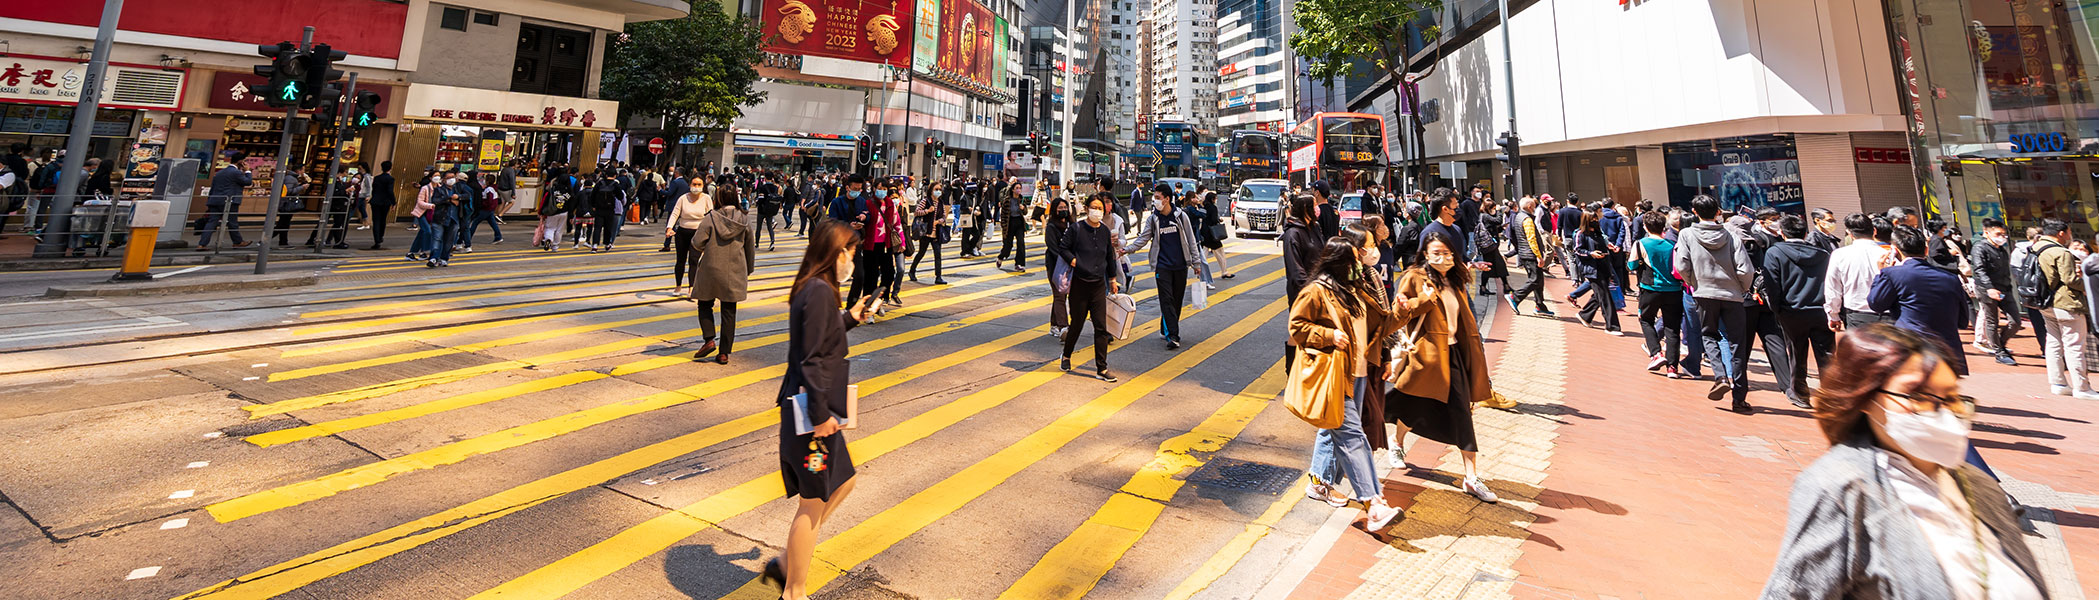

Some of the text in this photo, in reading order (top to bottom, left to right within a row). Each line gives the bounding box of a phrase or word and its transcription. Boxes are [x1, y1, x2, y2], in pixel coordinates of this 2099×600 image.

[827, 13, 858, 23] HAPPY
[827, 21, 857, 30] CHINESE
[826, 33, 856, 48] 2023
[431, 109, 535, 124] BEE CHENG HIANG
[2009, 132, 2064, 153] SOGO
[1357, 152, 1373, 161] 603
[1724, 155, 1739, 164] Oral-B
